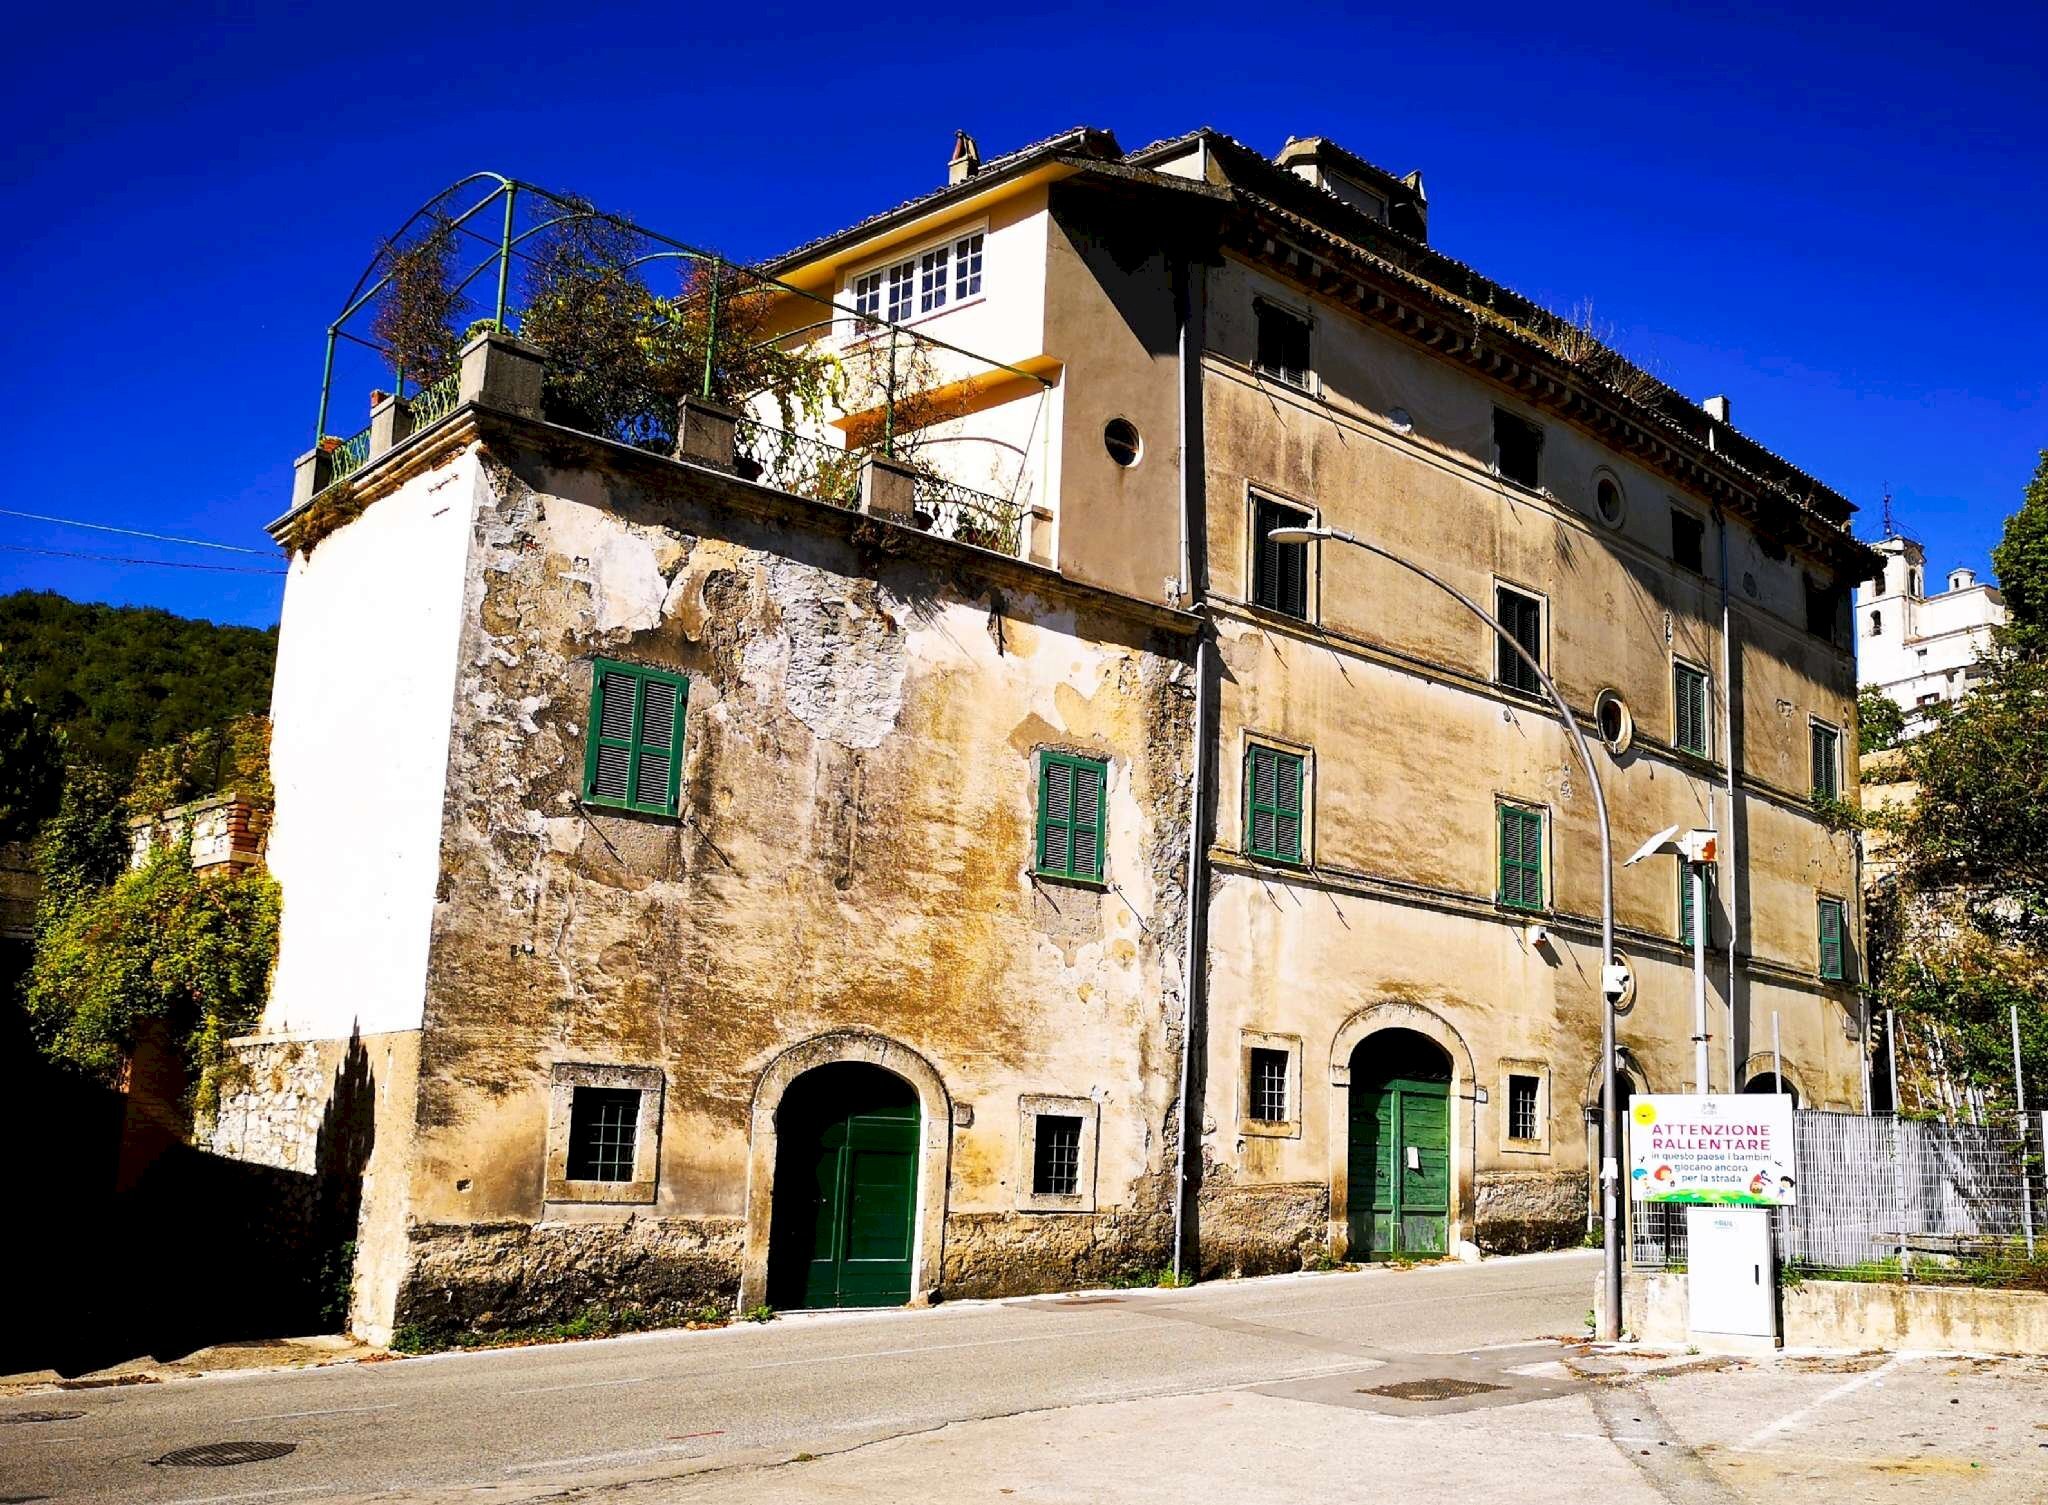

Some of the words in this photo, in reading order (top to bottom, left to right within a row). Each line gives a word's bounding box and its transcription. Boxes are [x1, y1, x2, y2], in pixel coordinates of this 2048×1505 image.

[1652, 1124, 1770, 1136] ATTENZIONE
[1653, 1139, 1770, 1150] RALLENTARE
[1662, 1153, 1695, 1161] questo
[1696, 1154, 1725, 1162] paese
[1733, 1153, 1771, 1161] bambini
[1674, 1163, 1712, 1173] giocano
[1682, 1175, 1698, 1183] per
[1700, 1174, 1709, 1182] la
[1711, 1174, 1742, 1182] strada
